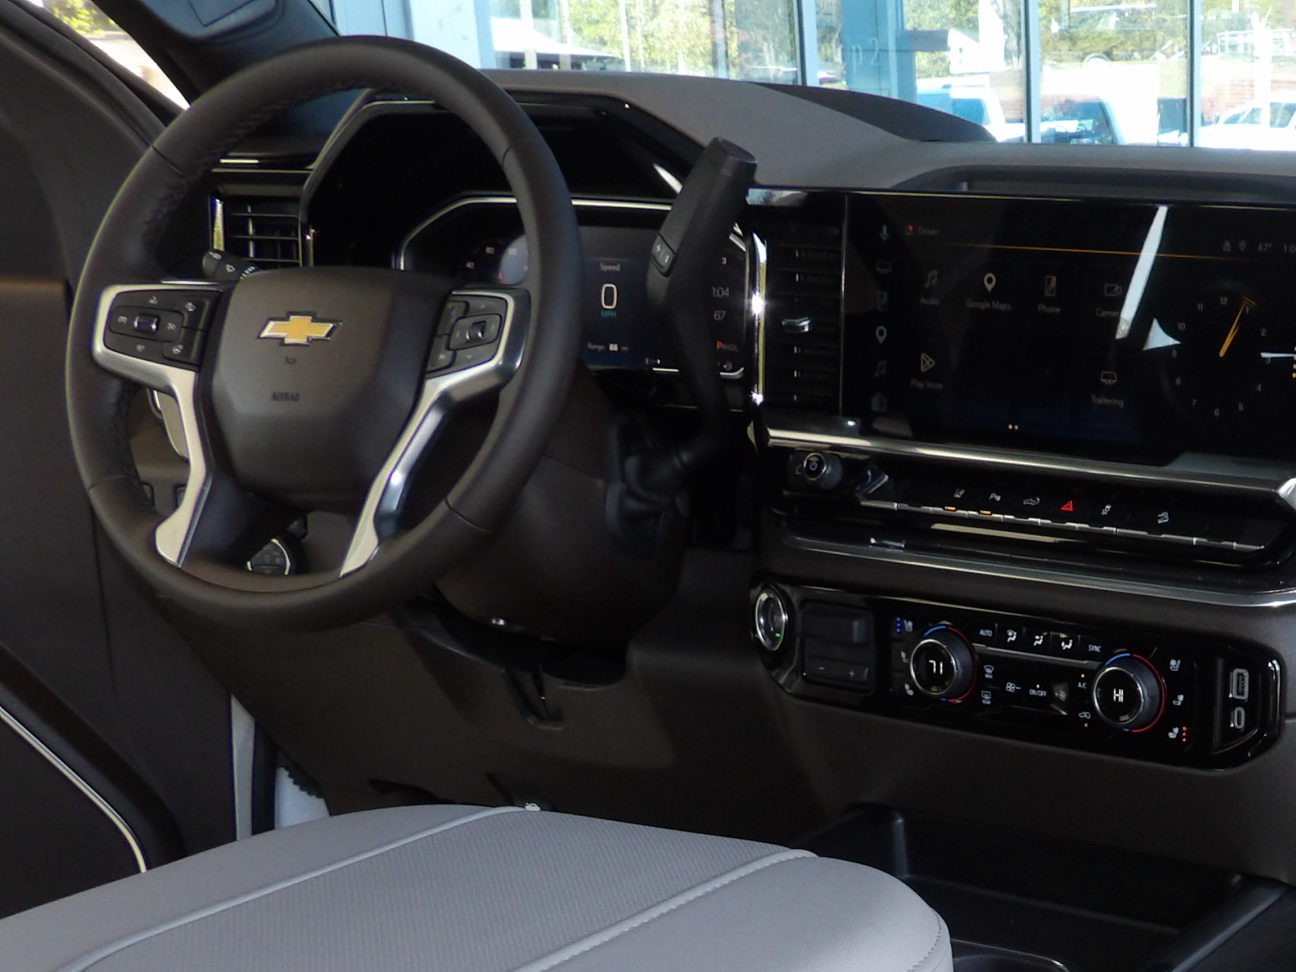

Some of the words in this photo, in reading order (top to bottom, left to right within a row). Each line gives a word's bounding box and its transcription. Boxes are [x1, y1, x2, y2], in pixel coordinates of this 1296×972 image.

[601, 283, 618, 310] 0
[928, 659, 944, 676] 71
[1112, 688, 1124, 703] HI
